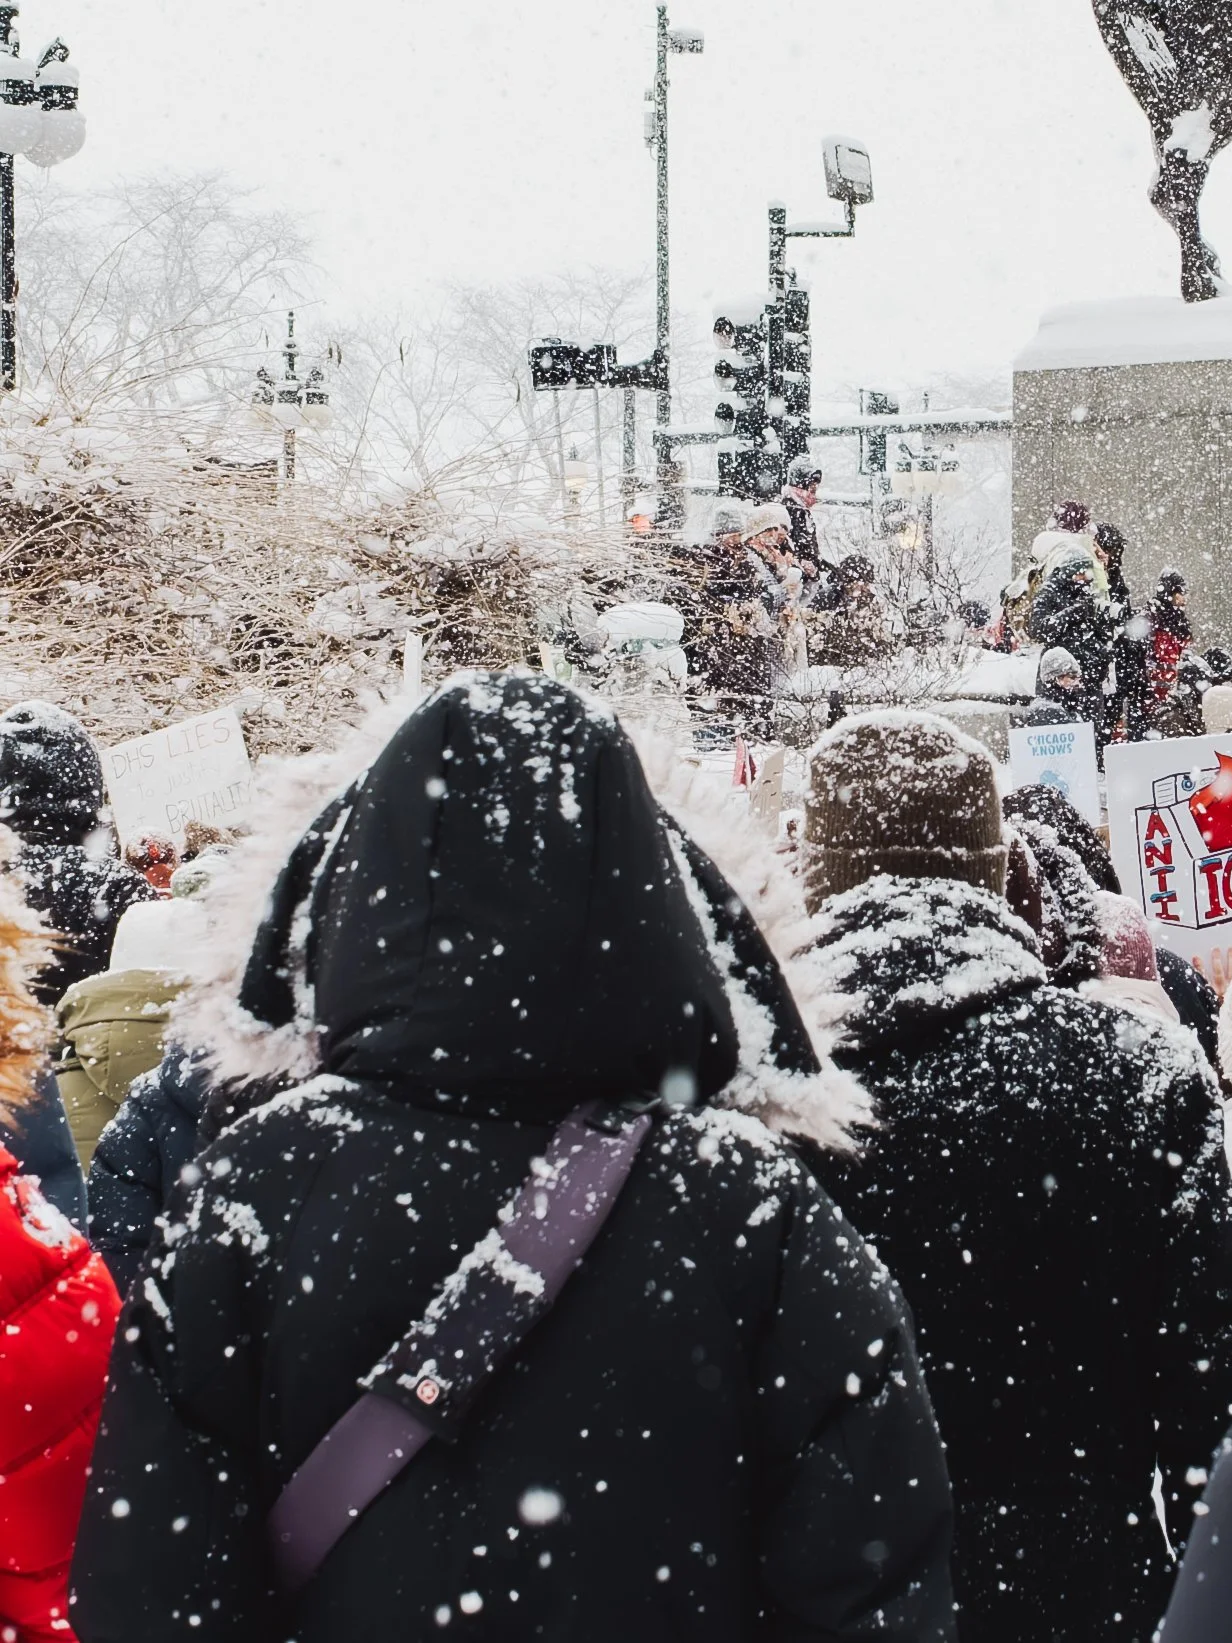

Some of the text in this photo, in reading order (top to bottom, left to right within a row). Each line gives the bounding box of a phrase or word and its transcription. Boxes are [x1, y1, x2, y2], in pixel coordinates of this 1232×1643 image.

[111, 717, 230, 779] DHS LIES
[1027, 732, 1075, 746] CHICAGO
[1032, 743, 1073, 756] KNOWS
[165, 778, 254, 834] BRUTALITY
[1145, 811, 1180, 921] ANTI
